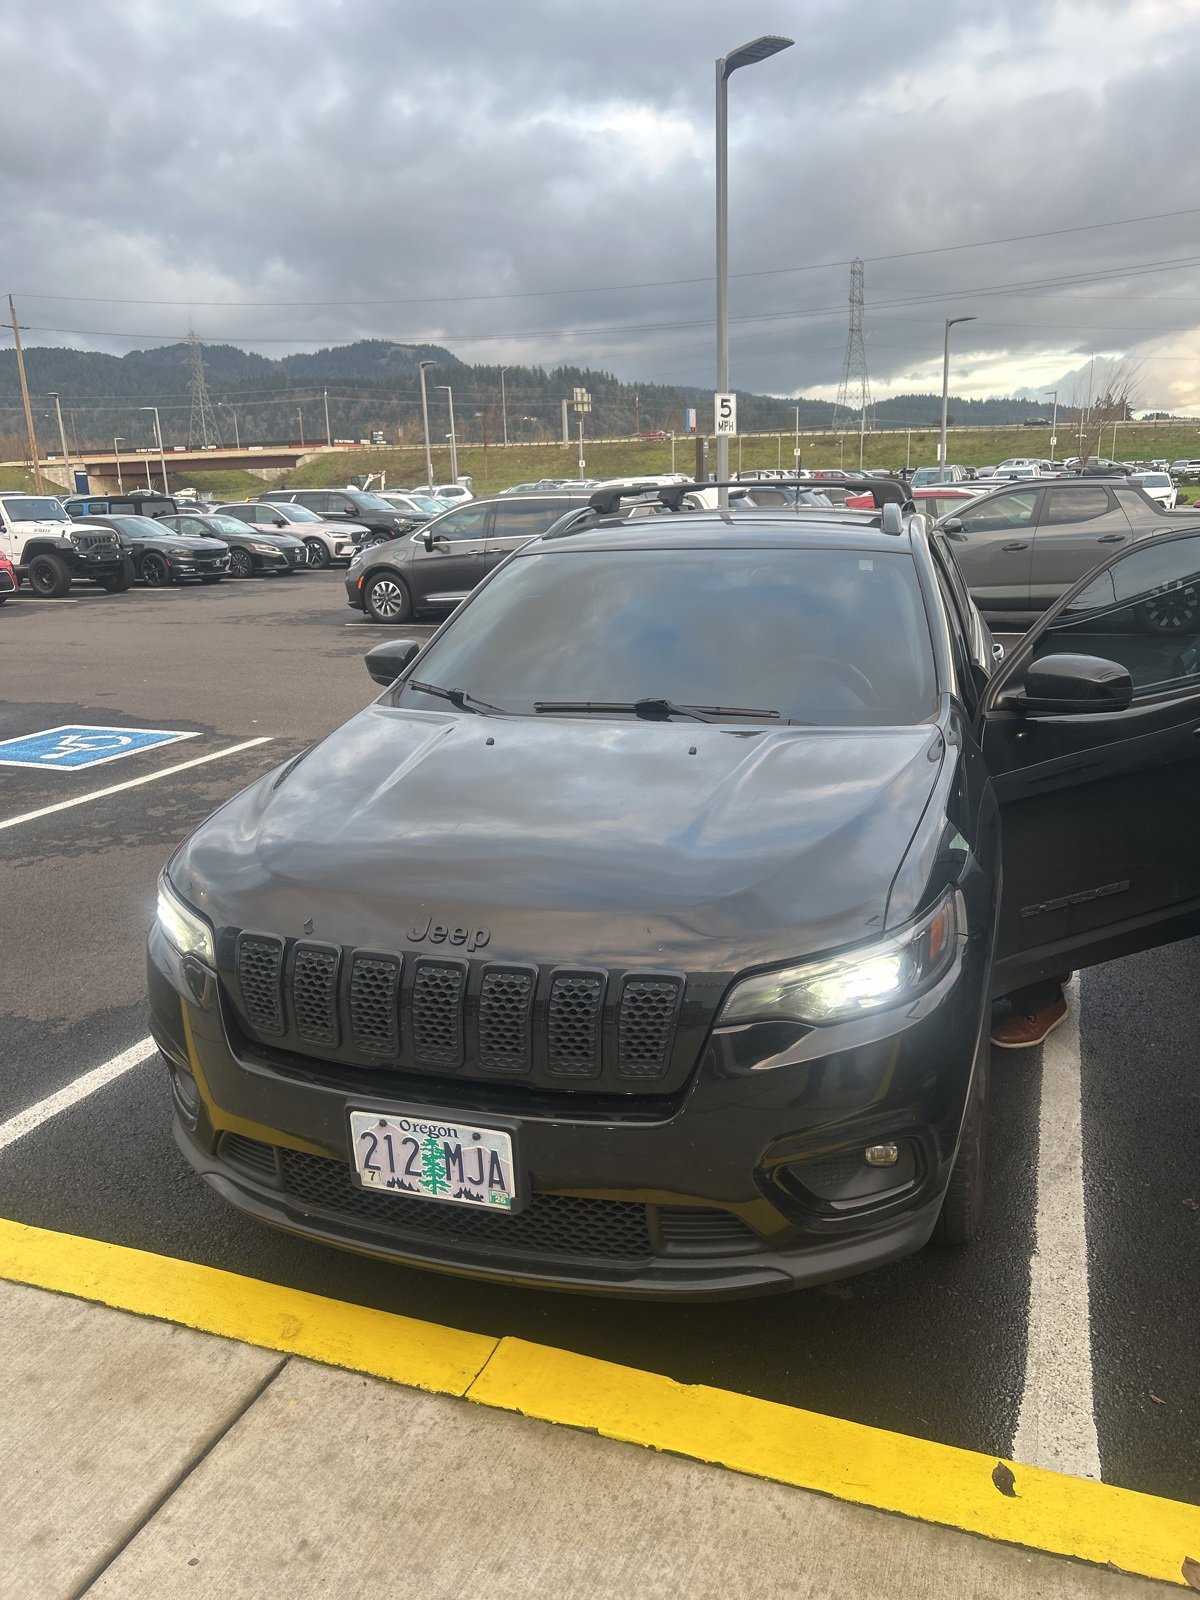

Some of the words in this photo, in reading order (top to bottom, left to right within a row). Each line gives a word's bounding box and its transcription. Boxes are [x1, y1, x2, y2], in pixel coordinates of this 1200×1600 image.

[720, 398, 732, 418] 5
[718, 421, 734, 431] MPH
[406, 914, 491, 952] Jeep
[400, 1119, 459, 1139] Oregon
[360, 1131, 422, 1177] 212
[443, 1141, 506, 1190] MJA
[368, 1171, 376, 1181] 7
